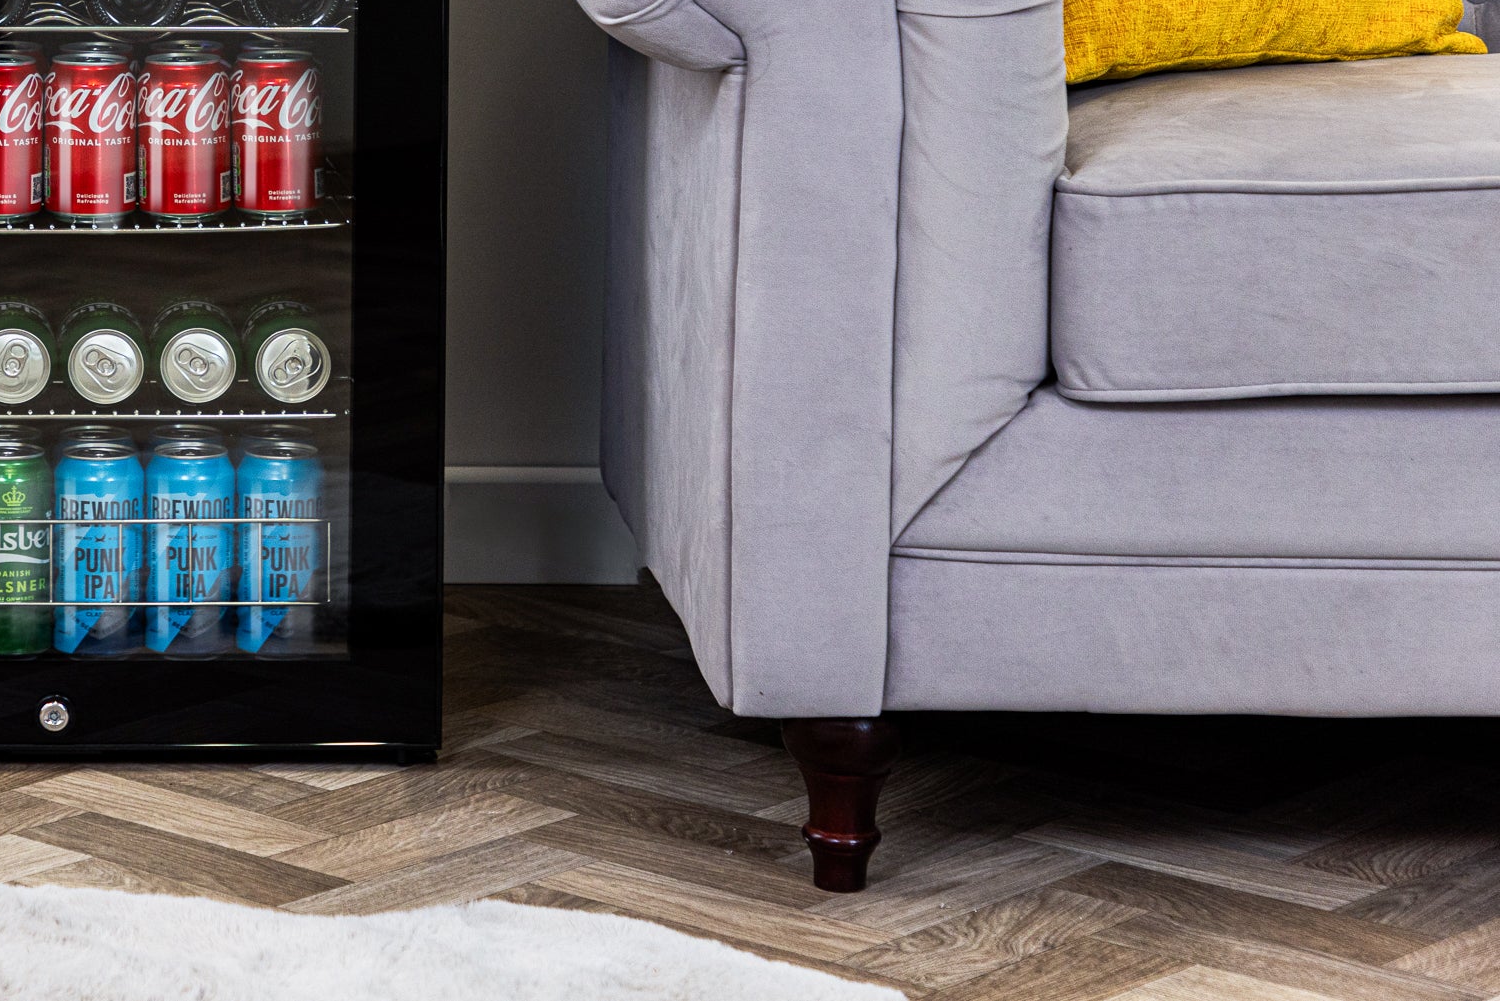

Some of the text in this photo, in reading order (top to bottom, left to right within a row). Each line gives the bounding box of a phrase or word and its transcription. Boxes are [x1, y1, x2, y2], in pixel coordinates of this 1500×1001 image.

[13, 137, 38, 146] TASTE
[52, 136, 131, 146] ORIGINAL TASTE
[148, 136, 226, 146] ORIGINAL TASTE
[242, 132, 320, 143] ORIGINAL TASTE
[61, 497, 139, 527] BREWDOG
[152, 496, 230, 525] BREWDOG
[74, 547, 126, 572] PUNK
[166, 546, 217, 571] PUNK
[261, 546, 310, 571] PUNK
[85, 575, 115, 599] IPA
[176, 573, 206, 598] IPA
[269, 573, 300, 598] IPA
